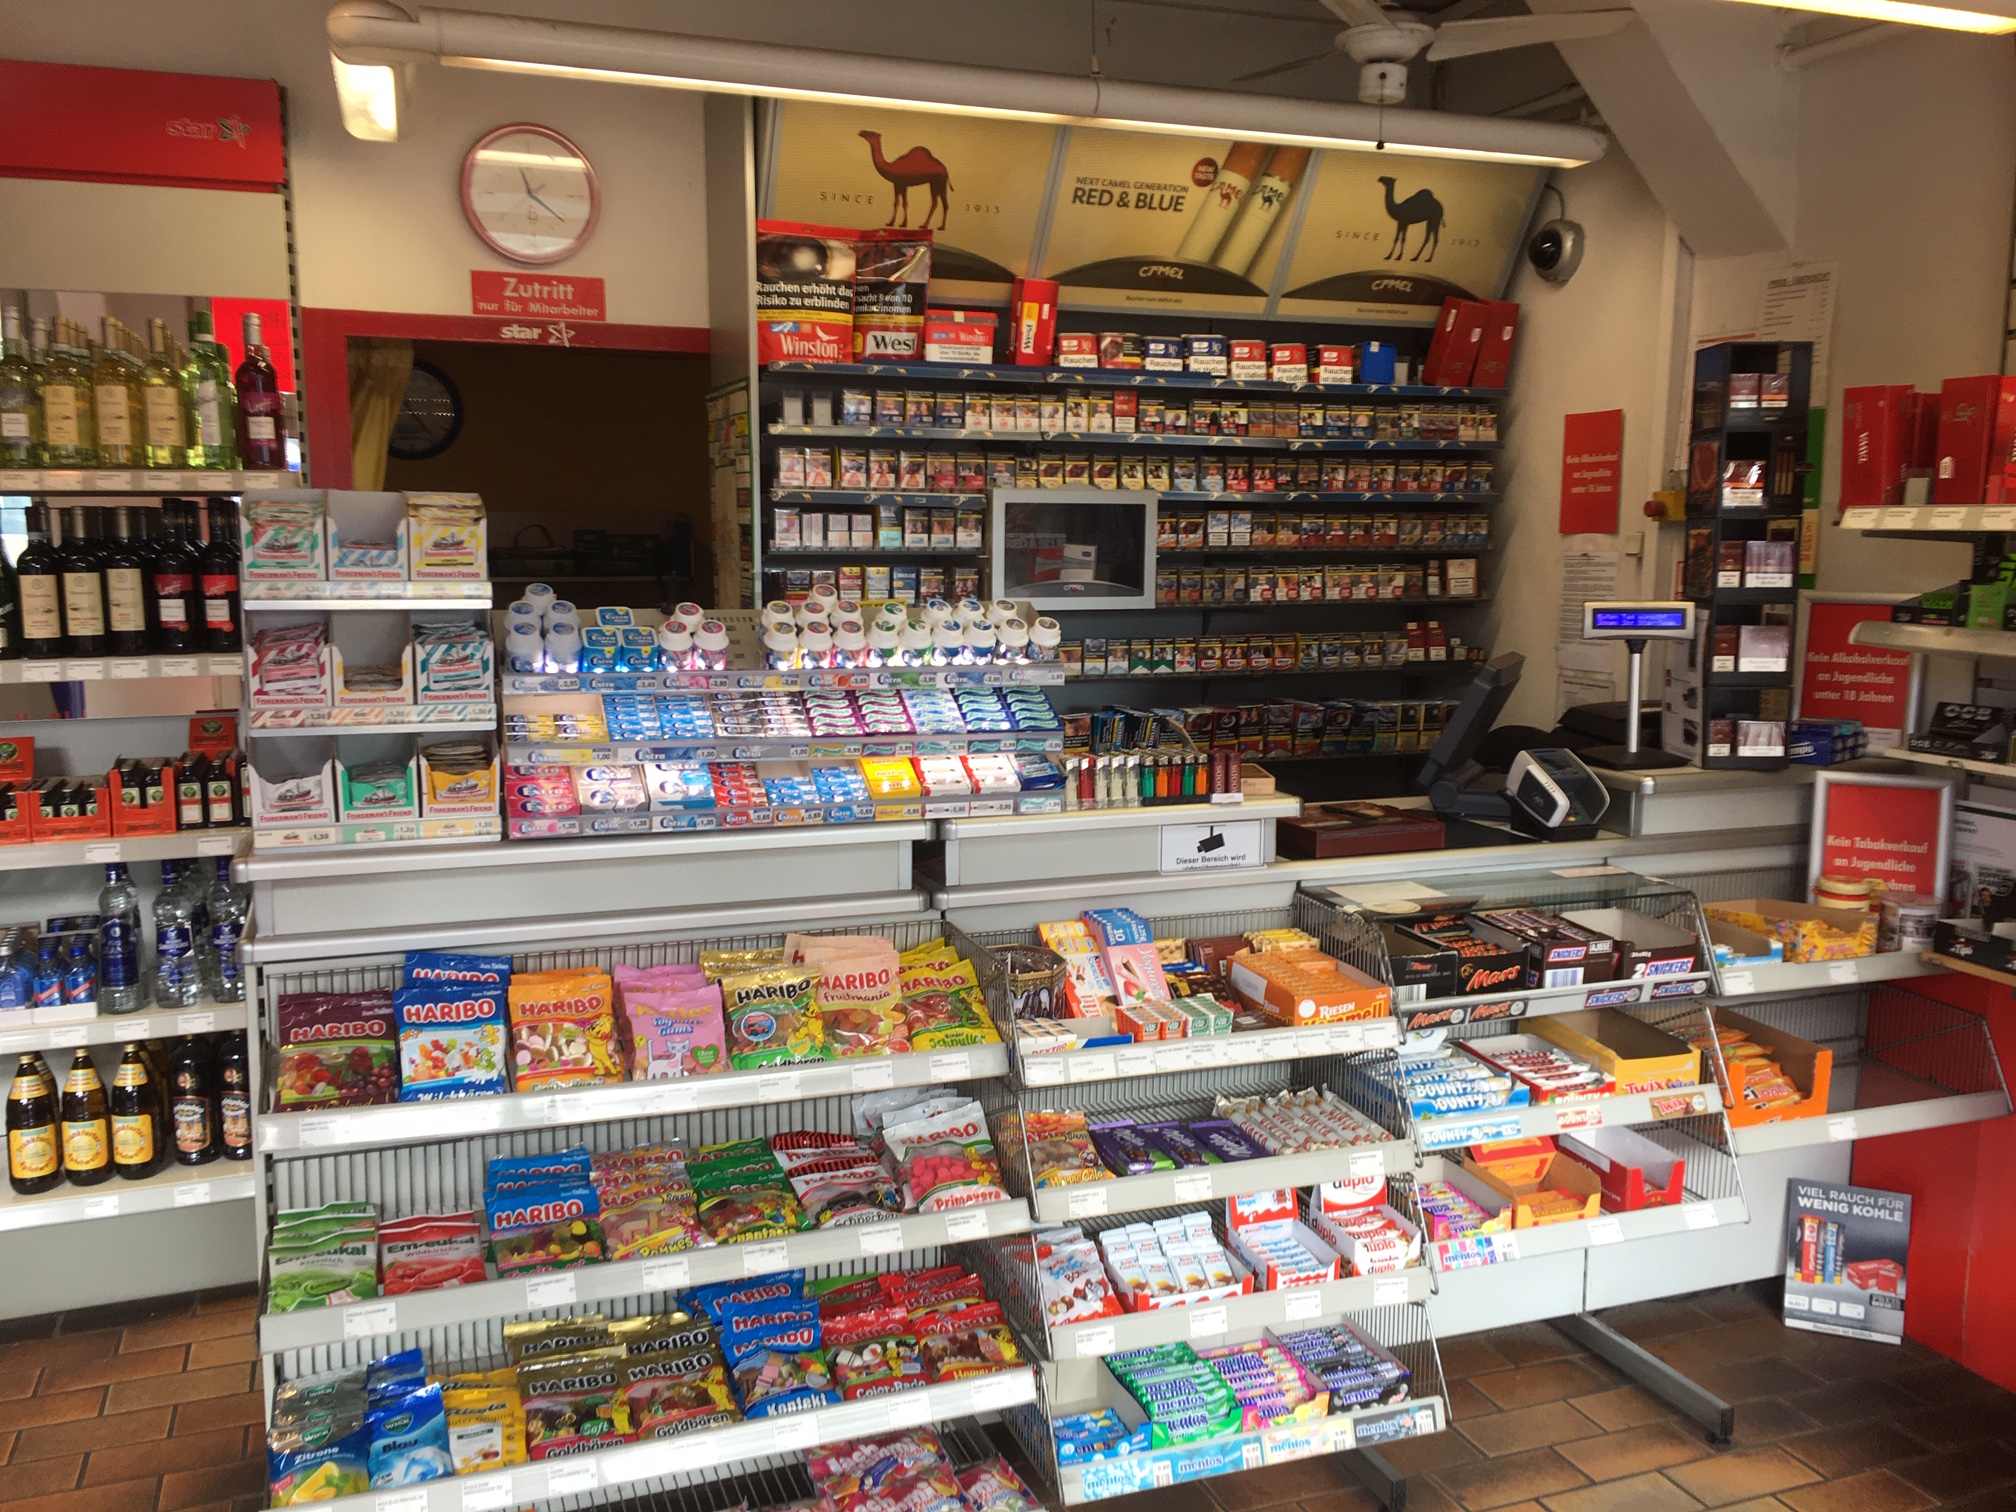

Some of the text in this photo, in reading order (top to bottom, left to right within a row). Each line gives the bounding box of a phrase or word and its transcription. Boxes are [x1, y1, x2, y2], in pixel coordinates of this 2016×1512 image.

[819, 190, 875, 205] SINCE
[1072, 186, 1186, 212] RED & BLUE
[1335, 229, 1381, 241] SINCE
[1138, 264, 1185, 280] CAMEL
[502, 277, 575, 300] Zutritt
[756, 281, 853, 297] Rauchen erhöht das
[477, 300, 599, 317] nur für Mitarbeiter
[757, 294, 850, 310] Risiko zu erblinden
[500, 323, 543, 340] star
[780, 333, 838, 358] Winston
[873, 334, 917, 352] West
[293, 571, 317, 579] FRIEND
[378, 570, 401, 579] FRIEND
[1807, 651, 1911, 667] Kein Alkoholverkauf
[1832, 671, 1895, 685] Jugendliche
[382, 695, 406, 703] FRIEND
[1813, 690, 1841, 701] unter
[1858, 690, 1895, 703] Jahren
[634, 748, 665, 762] Extra
[561, 822, 577, 830] 1,35
[632, 819, 648, 827] 1,35
[700, 818, 715, 827] 1,35
[1827, 835, 1929, 854] Kein Tabakverkauf
[1176, 857, 1200, 865] Dieser
[1201, 855, 1229, 864] Bereich
[1833, 857, 1917, 873] an Jugendliche
[1113, 929, 1126, 942] 10
[1550, 947, 1587, 961] SNICKERS
[1646, 958, 1692, 977] SNICKERS
[819, 969, 891, 991] HARIBO
[901, 975, 968, 991] HARIBO
[1465, 963, 1521, 993] Mars
[736, 978, 812, 1005] HARIBO
[823, 989, 892, 1003] fruitmania
[1658, 982, 1694, 995] SNICKERS
[518, 994, 604, 1016] HARIBO
[1588, 991, 1628, 1007] SNICKERS
[404, 998, 496, 1023] HARIBO
[1319, 1002, 1356, 1019] RIESEN
[1470, 1001, 1512, 1021] Mars
[1407, 1009, 1452, 1031] Mars
[290, 1020, 386, 1041] HARIBO
[658, 1026, 694, 1036] Gums
[929, 1035, 986, 1049] Schnuller
[1415, 1081, 1475, 1098] BOUNTY
[1624, 1078, 1666, 1094] Twix
[1654, 1096, 1687, 1115] Twix
[1422, 1126, 1472, 1144] BOUNTY
[1081, 1168, 1103, 1181] Cola
[1333, 1176, 1376, 1190] duplo
[933, 1189, 1002, 1209] Primavera
[1798, 1185, 1904, 1210] VIEL RAUCH FÜR
[1798, 1196, 1904, 1223] WENIG KOHLE
[1311, 1217, 1337, 1246] duplo
[1367, 1263, 1396, 1275] duplo
[1108, 1347, 1156, 1362] mentos
[1213, 1351, 1259, 1365] mentos
[1133, 1367, 1166, 1378] mentos
[1144, 1377, 1193, 1394] mentos
[1149, 1385, 1198, 1401] mentos
[766, 1392, 828, 1417] Konfekt
[1156, 1393, 1206, 1411] mentos
[385, 1416, 411, 1430] WICK
[583, 1420, 610, 1435] Saft
[655, 1413, 730, 1438] Goldbären
[303, 1427, 330, 1442] WICK
[382, 1438, 418, 1453] Blau
[546, 1438, 624, 1460] Goldbären
[294, 1446, 339, 1464] Zitrone
